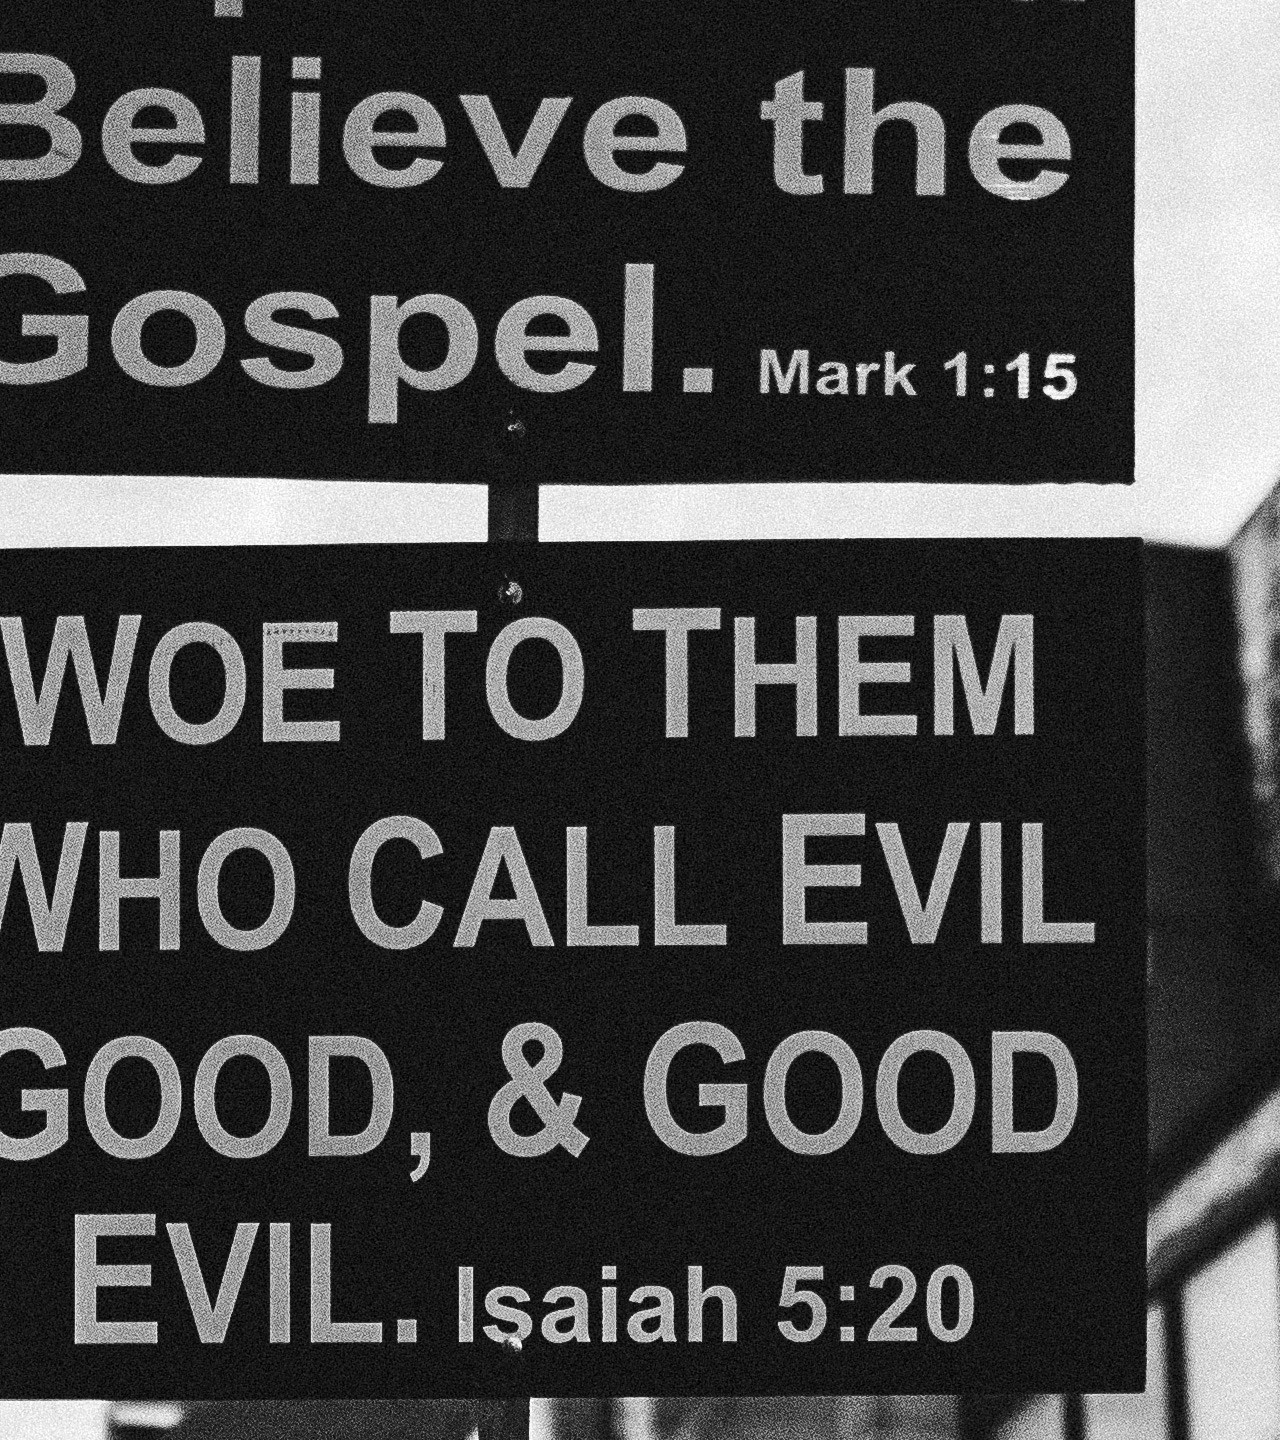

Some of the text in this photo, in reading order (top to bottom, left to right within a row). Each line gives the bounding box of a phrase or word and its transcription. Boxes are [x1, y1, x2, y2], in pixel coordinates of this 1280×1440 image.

[761, 67, 1072, 201] the
[760, 349, 916, 396] Mark
[945, 352, 1077, 401] 1:15
[0, 607, 1035, 746] WOE TO THEM
[348, 815, 727, 950] CALL
[782, 812, 1095, 945] EVIL
[487, 1021, 590, 1158] &
[643, 1020, 1079, 1156] GOOD
[73, 1213, 975, 1345] EVIL. Isaiah 5:20
